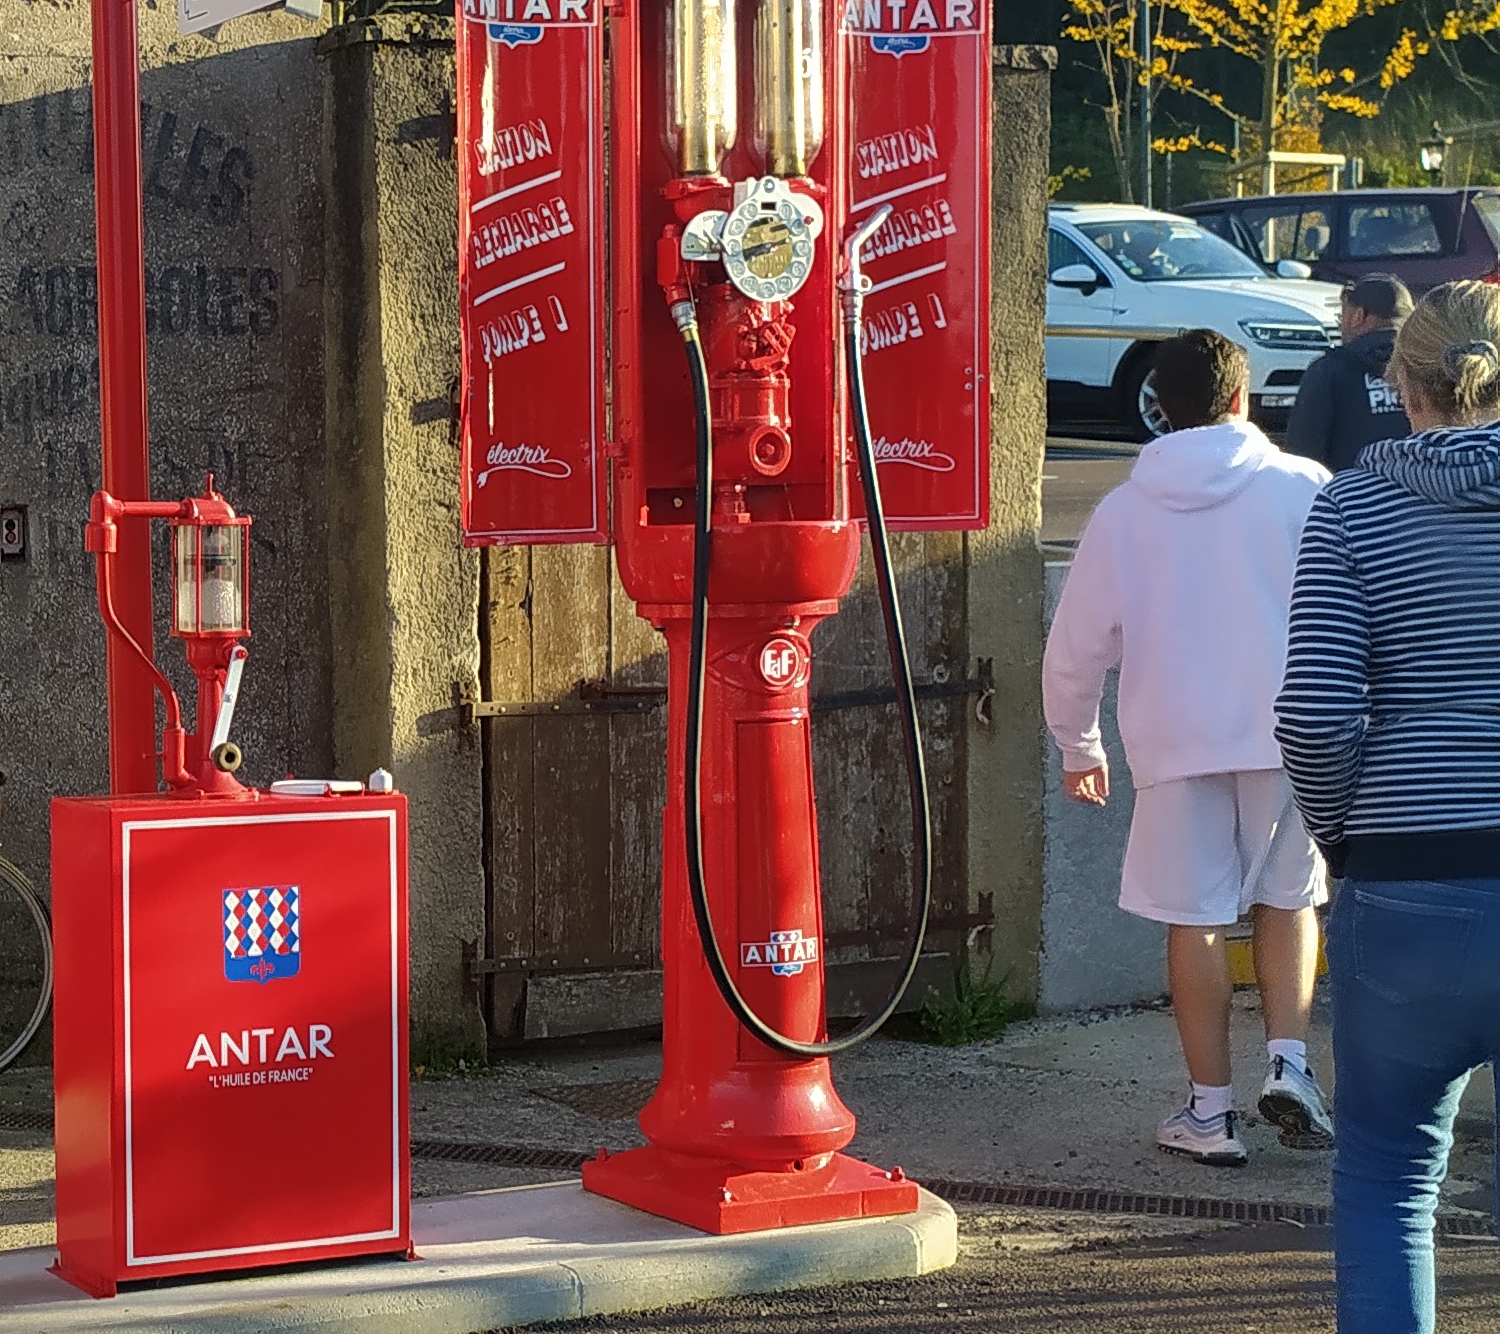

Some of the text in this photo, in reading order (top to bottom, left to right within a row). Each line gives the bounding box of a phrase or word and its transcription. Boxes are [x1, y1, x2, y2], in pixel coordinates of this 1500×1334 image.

[856, 124, 938, 179] STATION
[472, 196, 574, 269] RECHARGE
[477, 304, 546, 363] POMPE
[487, 442, 550, 464] électrix
[764, 649, 794, 678] EdF
[745, 940, 816, 963] ANTAR
[185, 1024, 335, 1069] ANTAR
[209, 1067, 313, 1088] "L'HUILE DE FRANCE"
